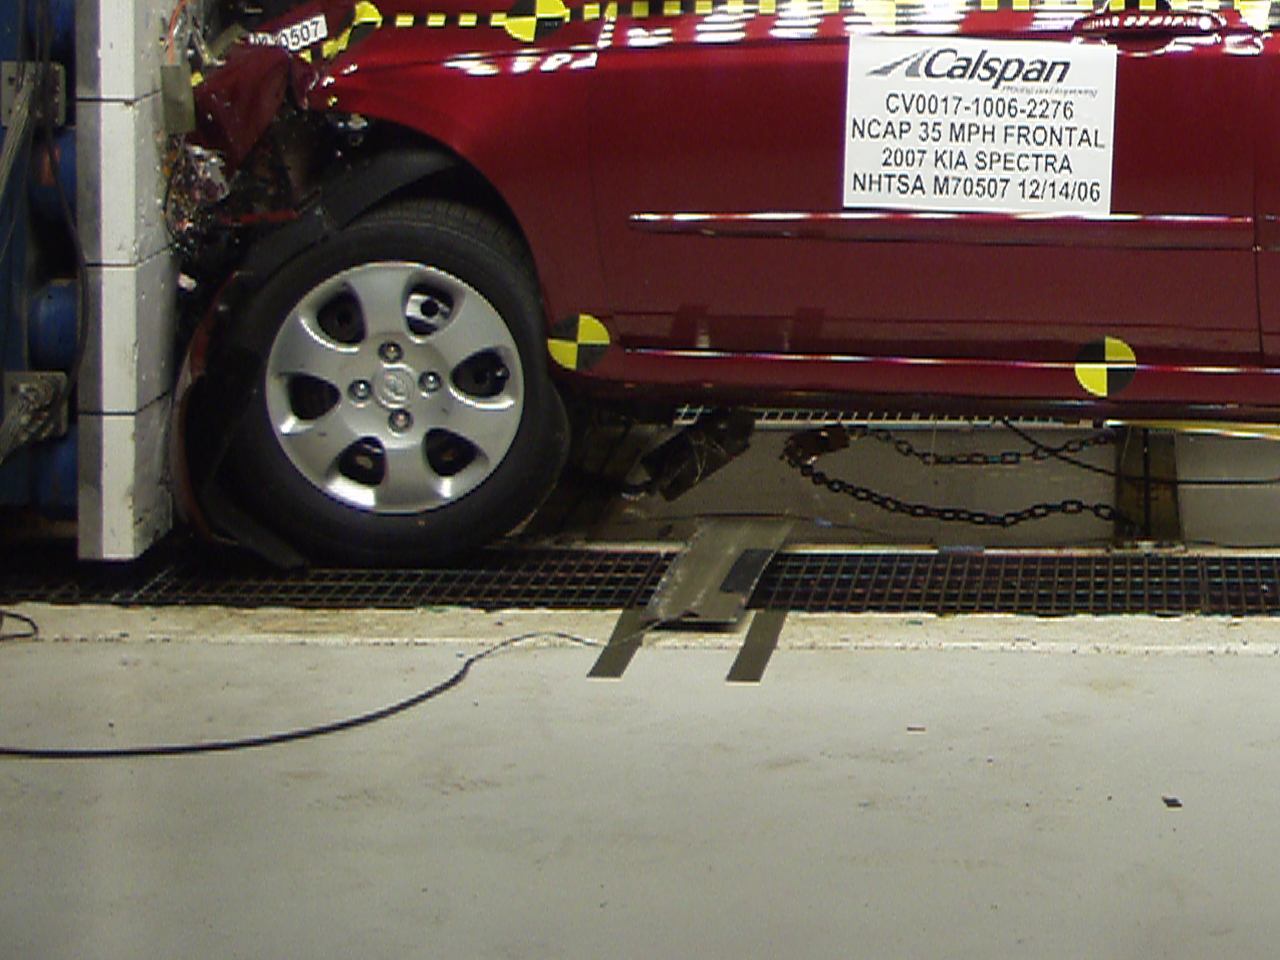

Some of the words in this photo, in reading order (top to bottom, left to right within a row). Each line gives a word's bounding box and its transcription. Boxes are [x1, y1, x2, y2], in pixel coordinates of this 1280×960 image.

[923, 48, 1071, 90] Calspan
[885, 93, 1075, 119] CV0017-1006-2276
[851, 118, 912, 141] NCAP
[918, 122, 942, 143] 35
[949, 123, 995, 144] MPH
[1003, 126, 1106, 149] FRONTAL
[881, 148, 928, 169] 2007
[934, 150, 968, 171] KIA
[974, 152, 1073, 175] SPECTRA
[852, 173, 926, 194] NHTSA
[933, 177, 1010, 199] M70507
[1018, 180, 1101, 203] 12/14/06
